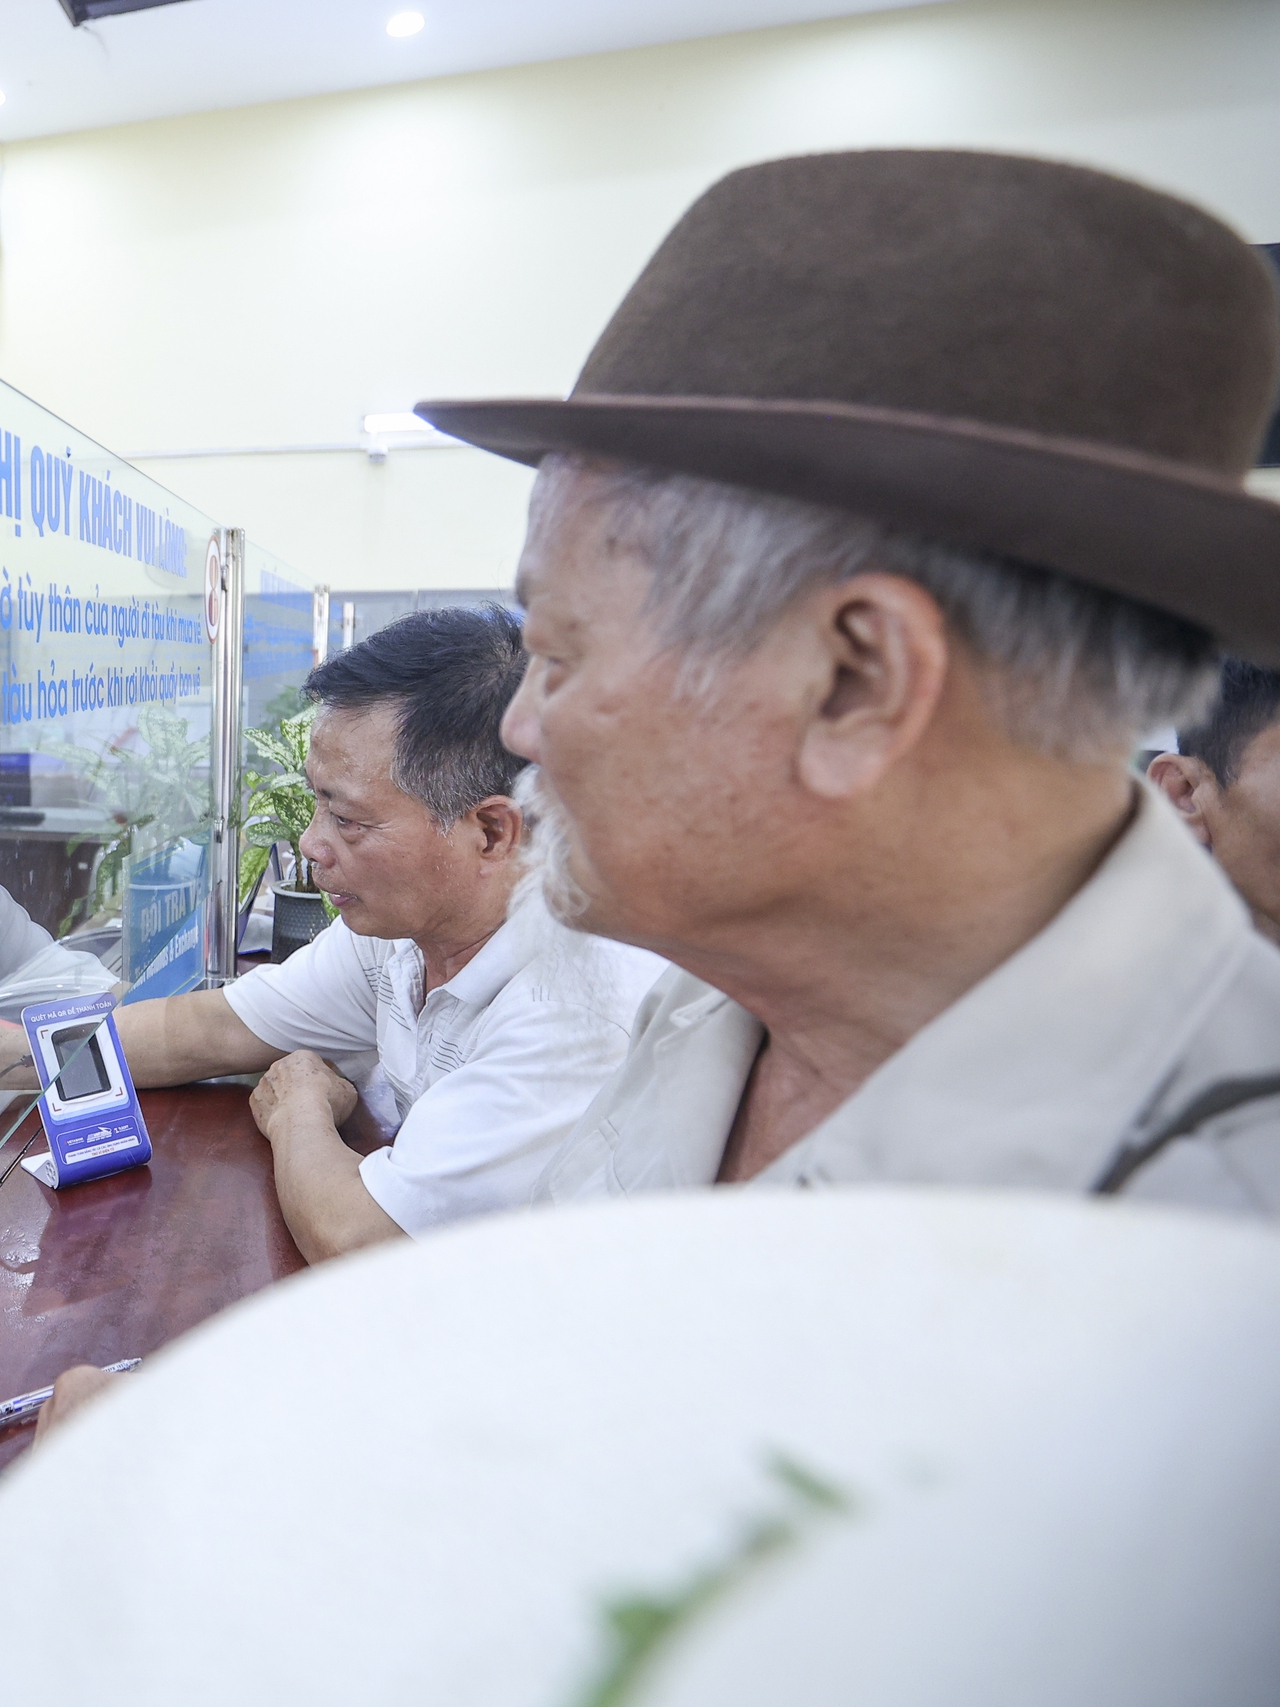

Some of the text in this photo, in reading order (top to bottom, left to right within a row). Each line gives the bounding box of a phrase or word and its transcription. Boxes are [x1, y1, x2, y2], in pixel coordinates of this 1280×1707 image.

[79, 469, 132, 558] KHÁCH
[136, 502, 156, 567] VUI
[18, 571, 44, 643] tùy
[48, 583, 81, 633] thân
[85, 583, 108, 636] của
[111, 594, 140, 648] người
[141, 600, 150, 640] đi
[151, 600, 165, 641] tàu
[166, 606, 177, 641] khi
[178, 616, 193, 644] mua
[3, 661, 32, 726] tàu
[37, 659, 68, 719] hỏa
[72, 662, 105, 713] trước
[107, 666, 123, 708] khi
[139, 660, 158, 703] khỏi
[57, 1010, 67, 1018] QR
[76, 1004, 96, 1014] THANH
[96, 1000, 112, 1010] TOÁN
